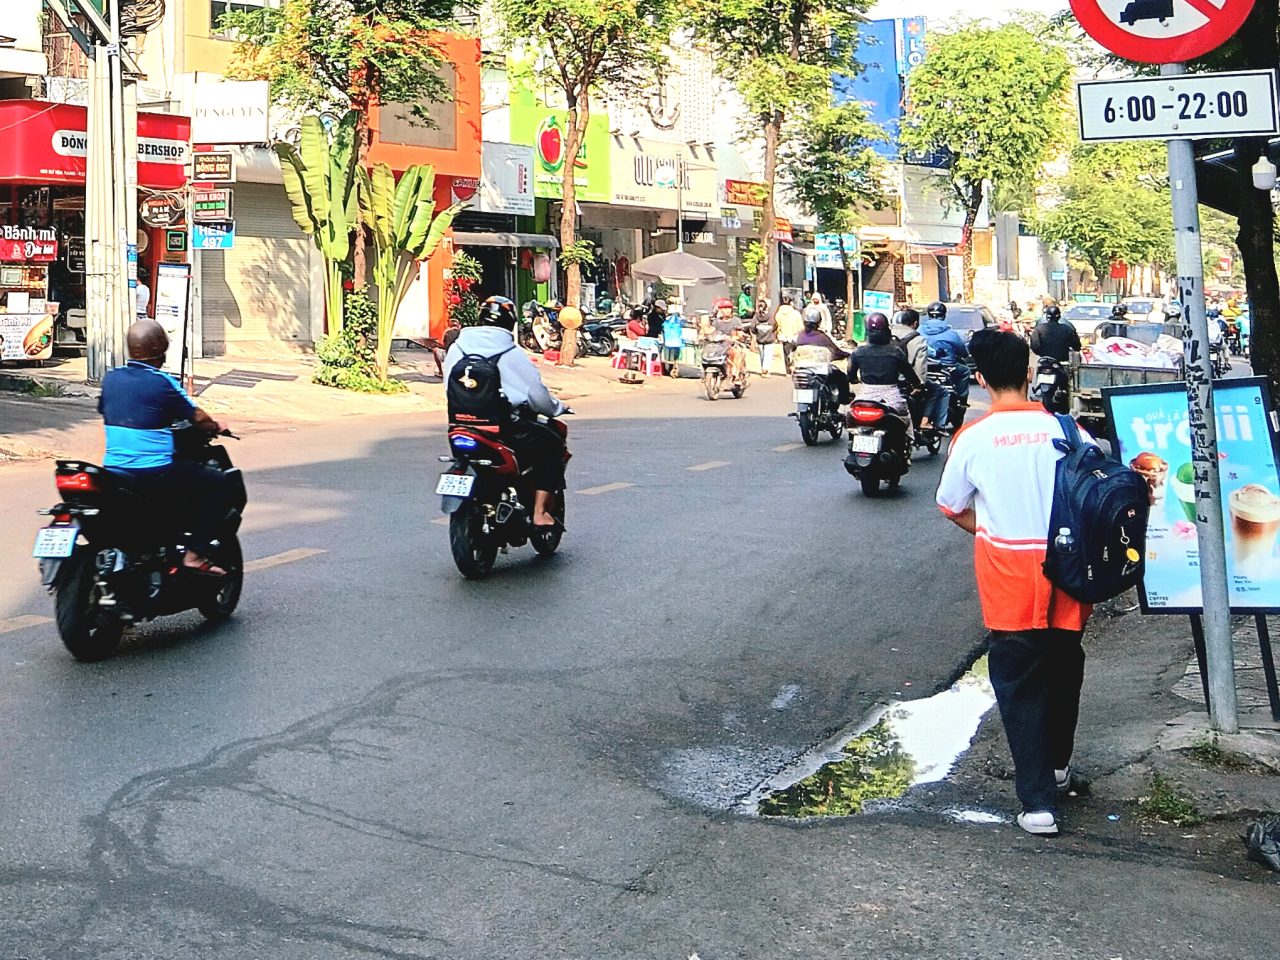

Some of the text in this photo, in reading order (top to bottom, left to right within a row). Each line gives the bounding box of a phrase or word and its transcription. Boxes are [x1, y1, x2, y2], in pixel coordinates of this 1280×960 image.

[137, 143, 185, 158] BERSHOP
[2, 224, 57, 241] Bánh mì
[201, 236, 224, 248] 497
